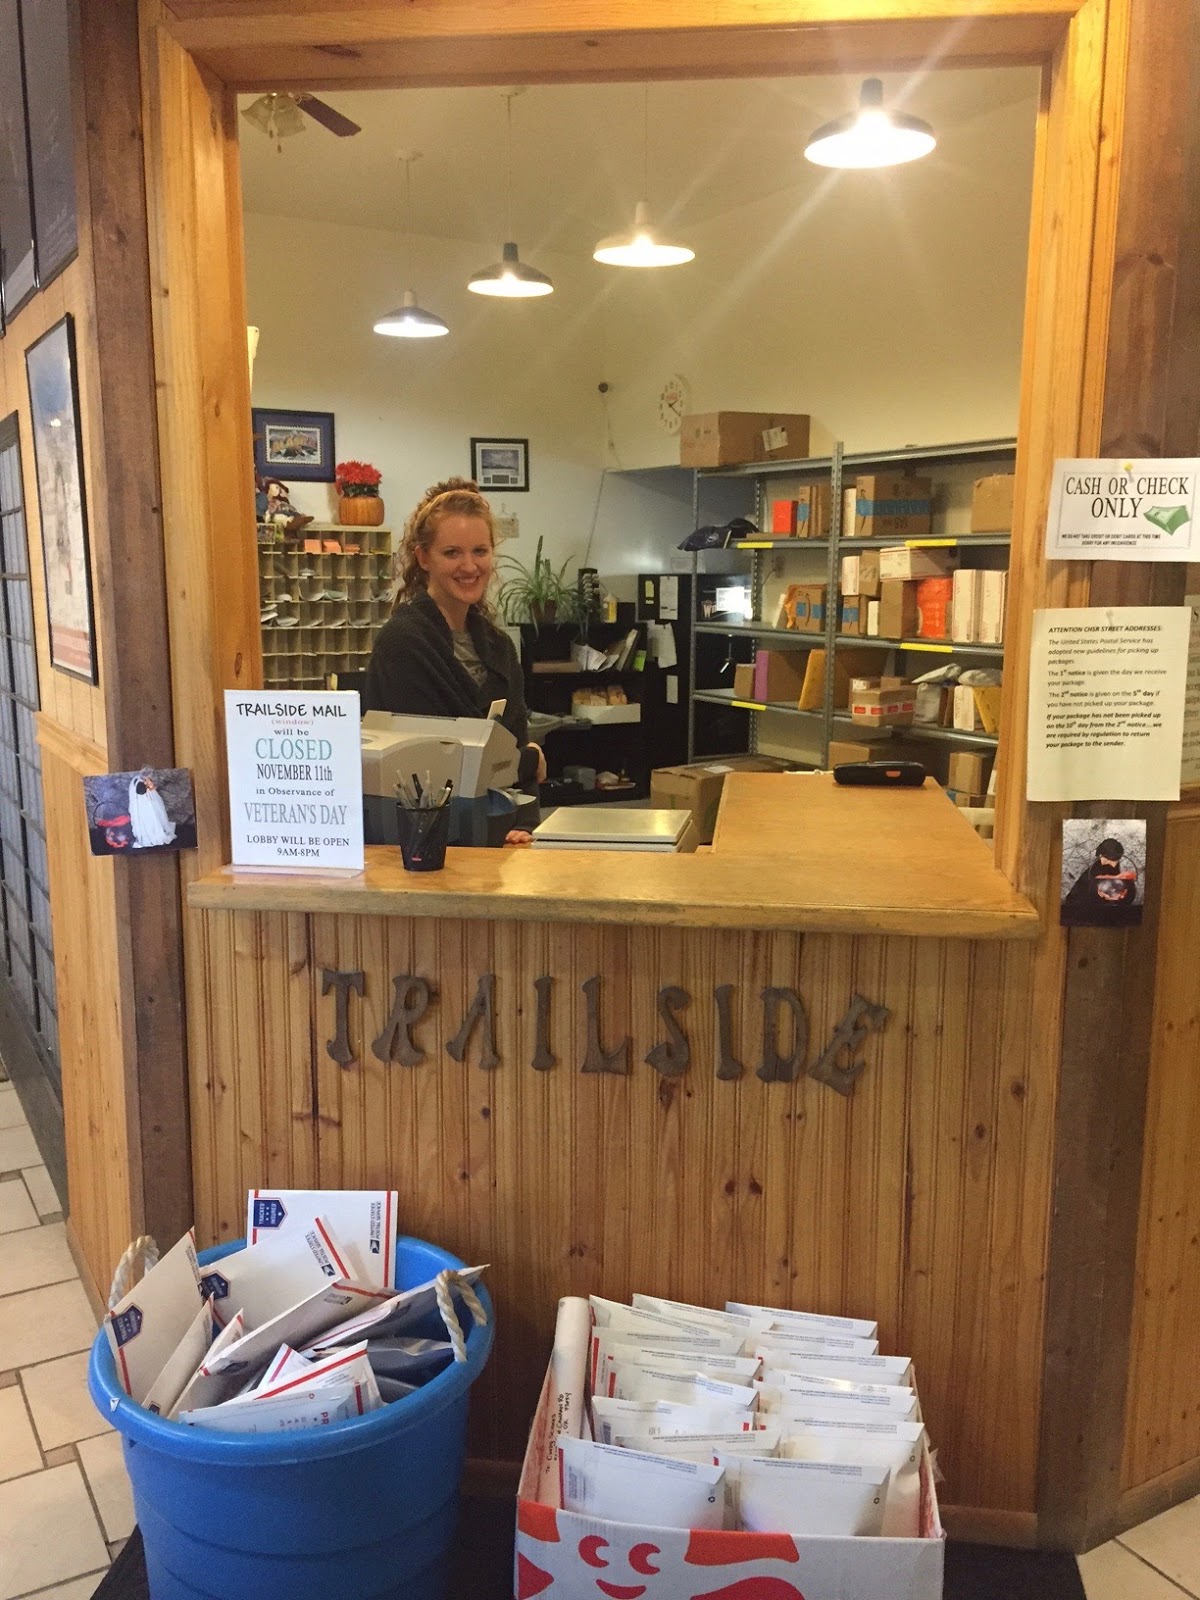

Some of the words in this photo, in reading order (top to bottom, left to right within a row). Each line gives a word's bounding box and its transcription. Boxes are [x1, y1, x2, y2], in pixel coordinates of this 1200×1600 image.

[1066, 477, 1102, 495] CASH
[1108, 477, 1128, 495] OR
[1136, 477, 1189, 495] CHECK
[1092, 498, 1143, 518] ONLY
[236, 703, 307, 717] TRAILSIDE
[312, 705, 346, 718] MAIL
[256, 738, 332, 760] CLOSED
[257, 764, 312, 781] NOVEMBER
[315, 765, 333, 781] 11th
[268, 788, 322, 796] Observance
[244, 803, 316, 824] VETERAN'S
[321, 805, 348, 825] DAY
[246, 834, 278, 844] LOBBY
[281, 836, 306, 845] WILL
[309, 837, 321, 846] BE
[323, 837, 349, 846] OPEN
[277, 848, 320, 857] 9AM-8PM
[322, 970, 891, 1097] TRAILSIDE
